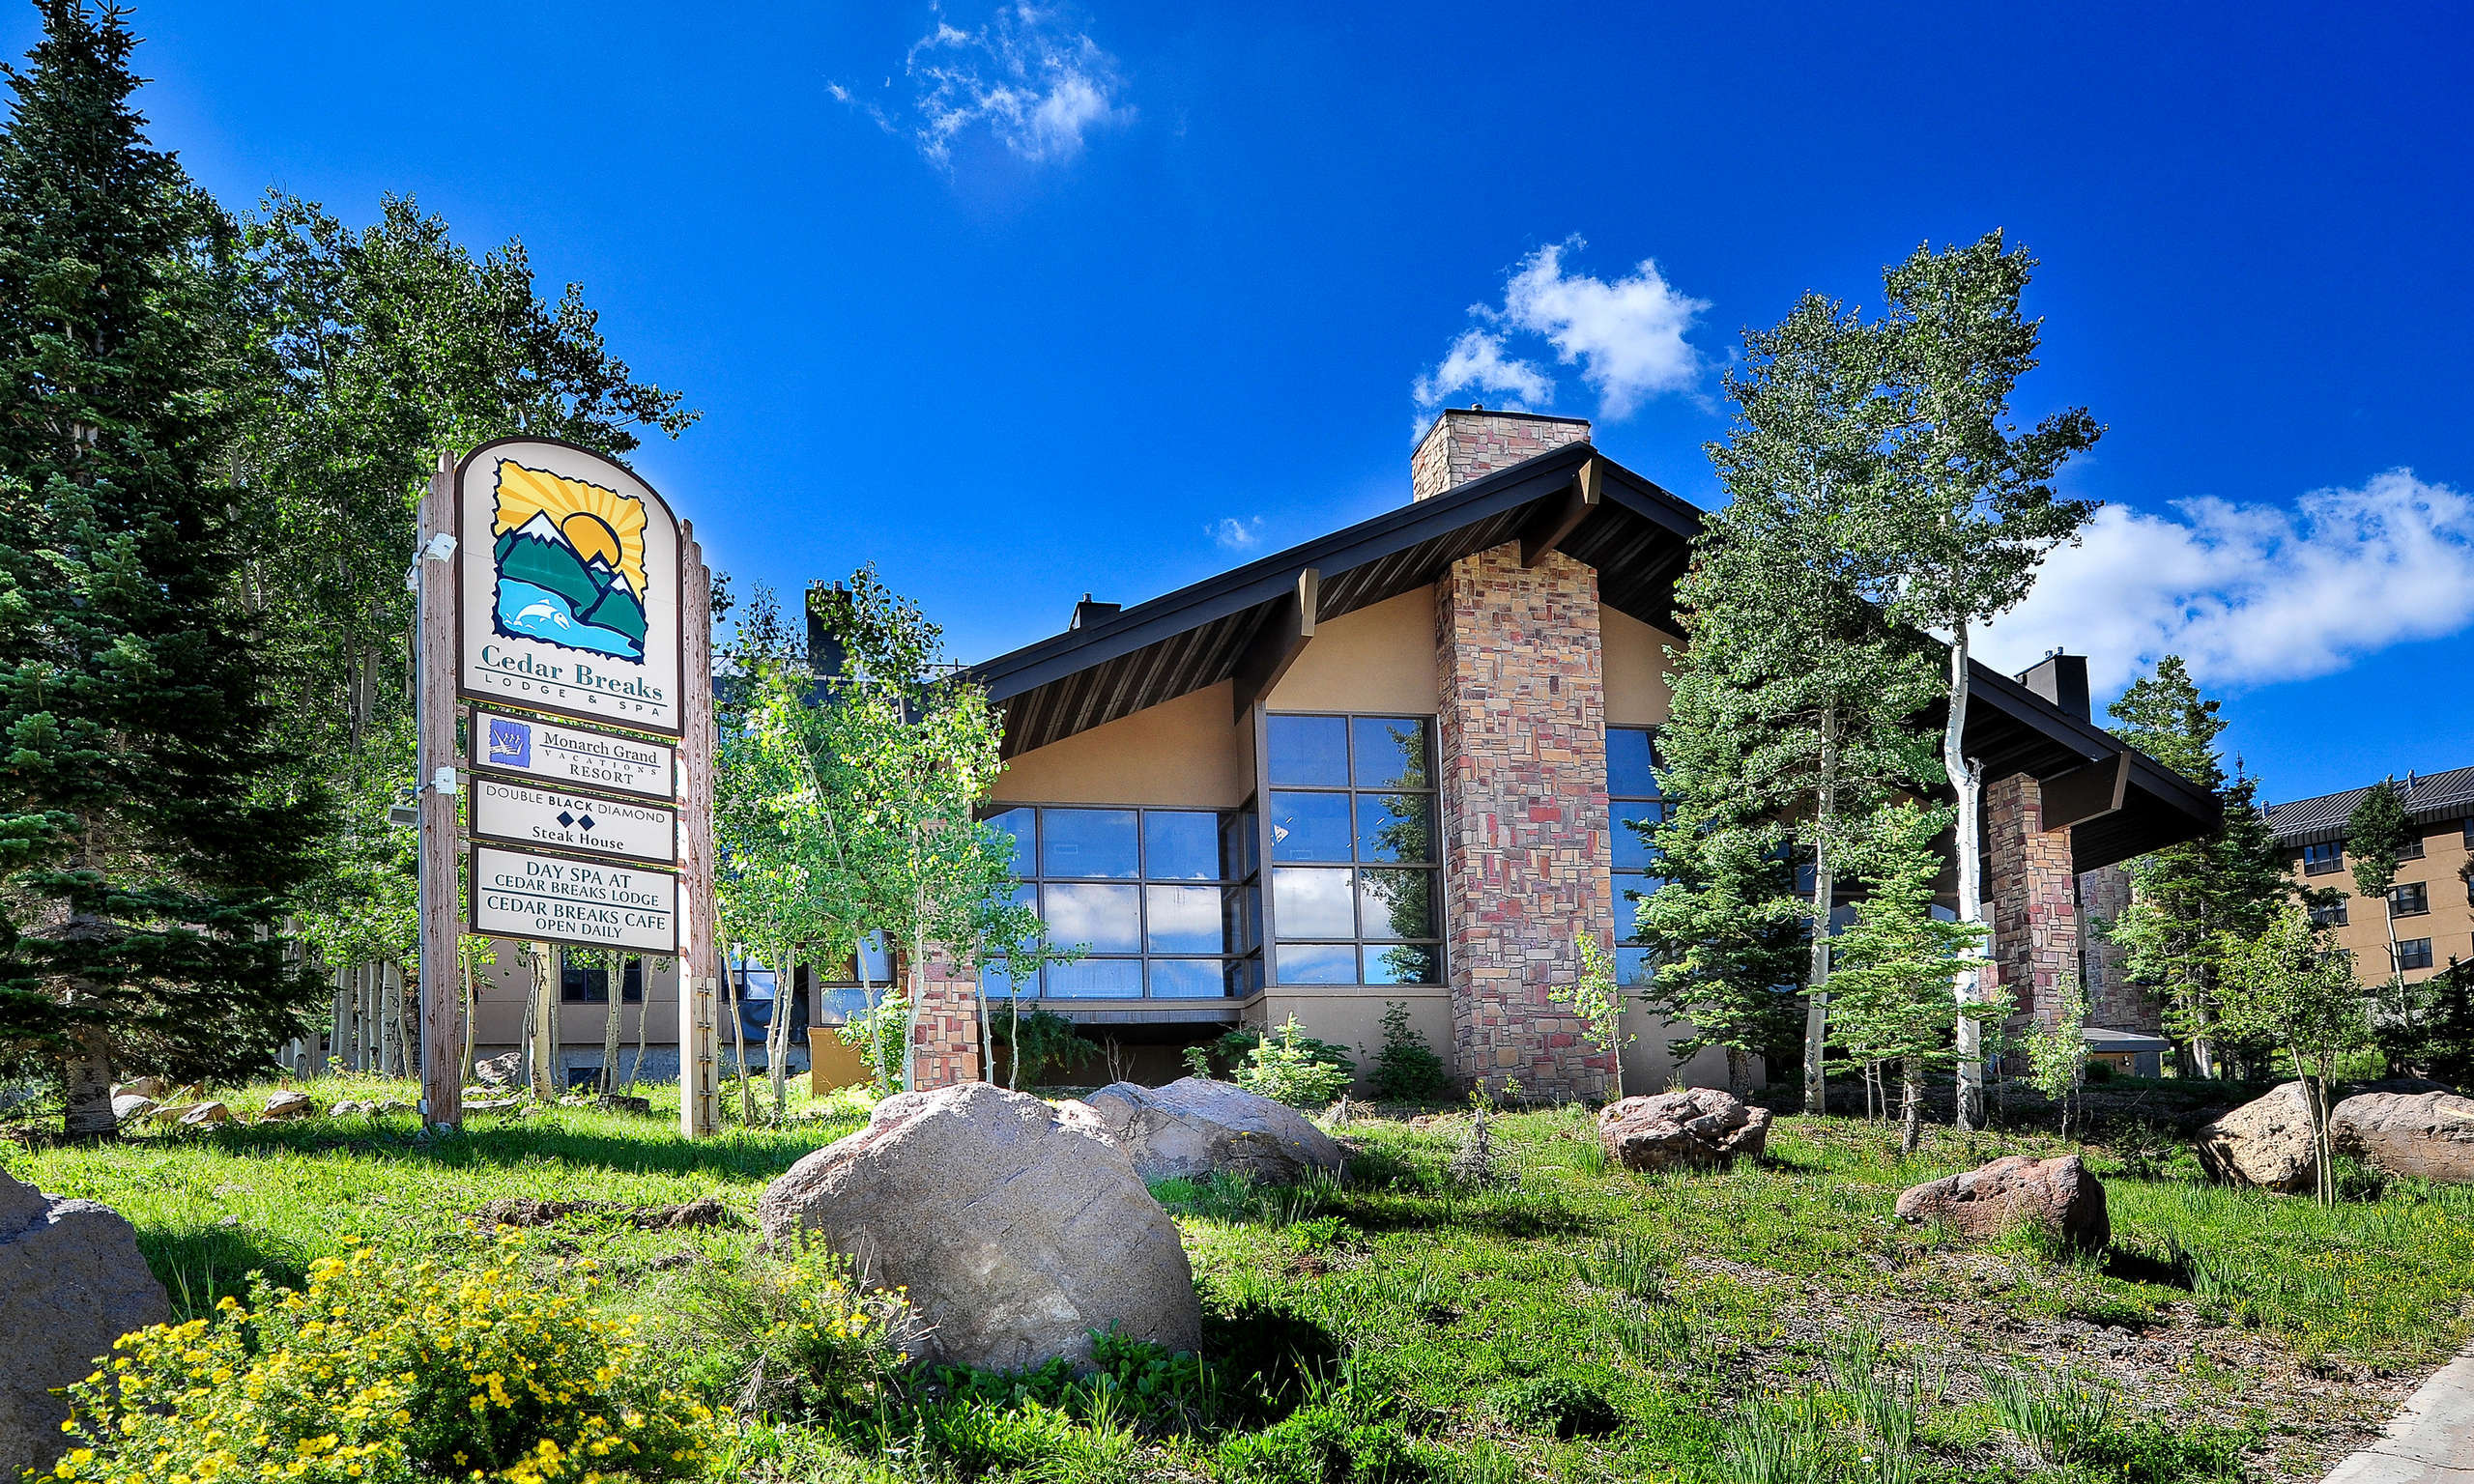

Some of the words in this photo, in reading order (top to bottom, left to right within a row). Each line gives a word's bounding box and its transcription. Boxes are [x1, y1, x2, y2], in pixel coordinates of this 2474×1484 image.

[482, 644, 563, 680] Cedar
[574, 663, 663, 701] Breaks
[485, 674, 565, 698] LODGE
[588, 695, 597, 704] &
[618, 700, 661, 717] SPA
[544, 732, 610, 756] Monarch
[614, 745, 657, 764] Grand
[544, 750, 657, 776] VACATIONS
[570, 763, 634, 785] RESORT
[486, 785, 543, 804] DOUBLE
[549, 796, 593, 813] BLACK
[598, 804, 665, 823] DIAMOND
[532, 826, 574, 843] Steak
[580, 833, 624, 850] House
[495, 873, 546, 892] CEDAR
[552, 881, 606, 899] BREAKS
[612, 890, 659, 907] LODGE
[527, 861, 564, 879] DAY
[570, 868, 602, 885] SPA
[609, 873, 631, 889] AT
[487, 896, 548, 916] CEDAR
[554, 903, 618, 925] BREAKS
[625, 913, 666, 930] CAFE
[535, 918, 576, 933] OPEN
[582, 923, 623, 939] DAILY
